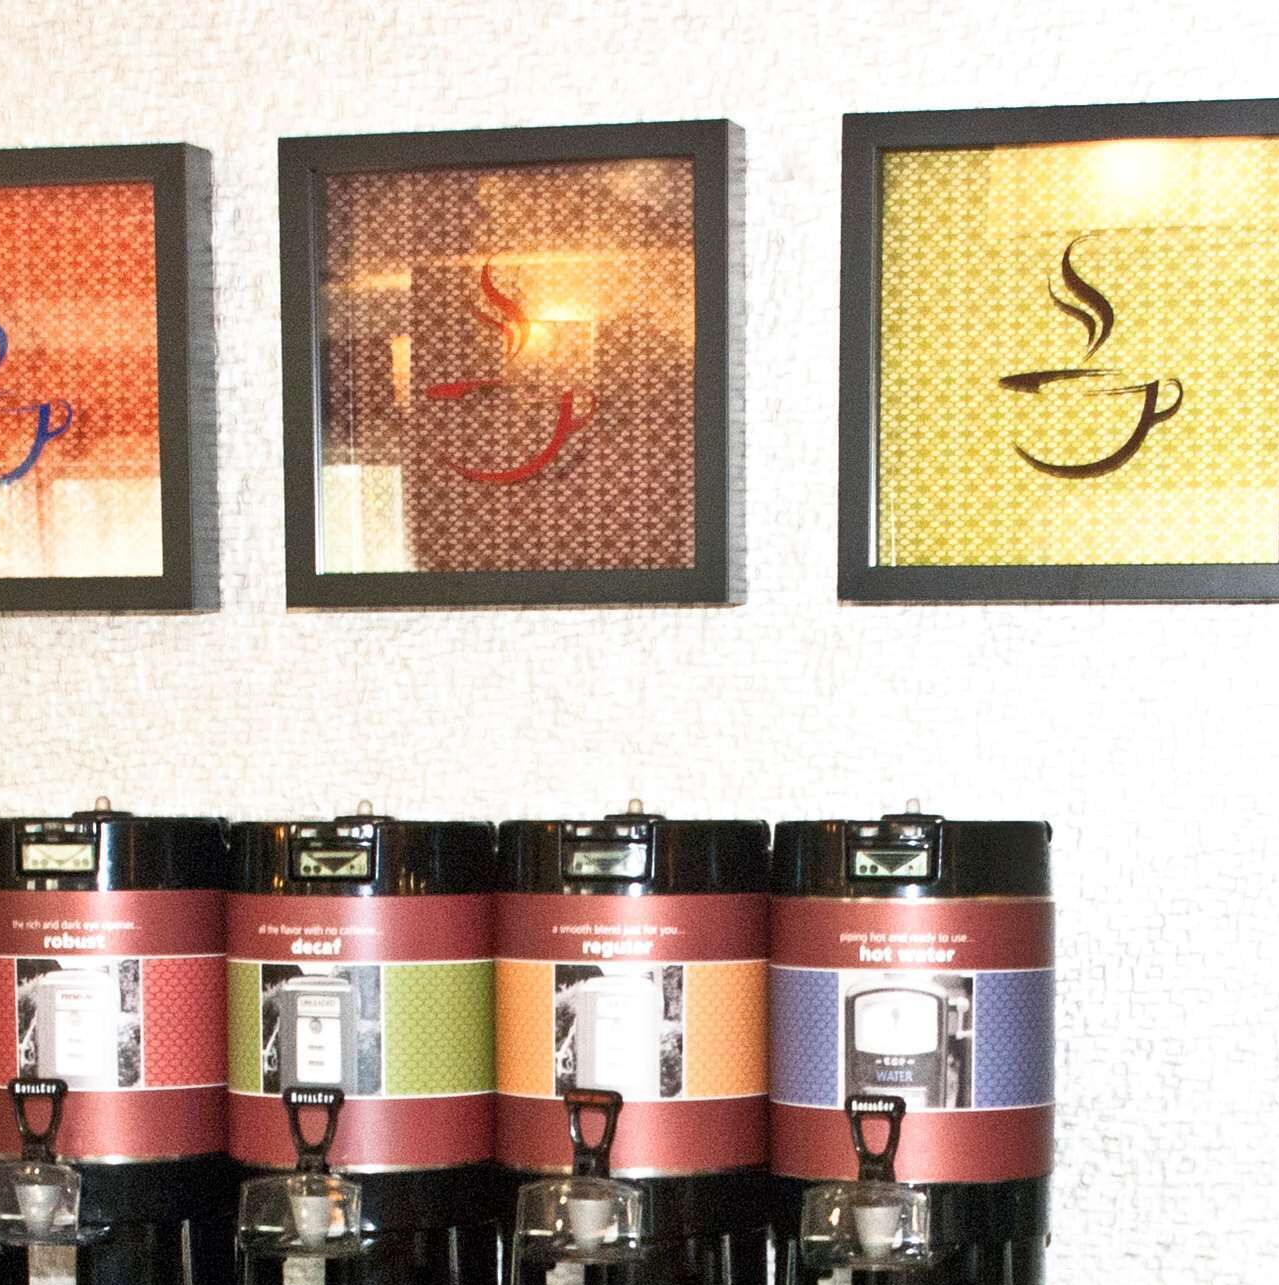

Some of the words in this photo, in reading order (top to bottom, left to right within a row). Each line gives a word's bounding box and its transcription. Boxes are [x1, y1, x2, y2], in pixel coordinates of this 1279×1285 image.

[43, 920, 59, 930] and
[61, 920, 81, 930] dark
[304, 925, 323, 935] with
[325, 927, 337, 935] no
[560, 925, 592, 934] smooth
[594, 924, 621, 934] blend
[43, 932, 106, 949] robust
[870, 932, 886, 942] hot
[938, 933, 949, 942] to
[291, 937, 342, 955] decaf
[582, 940, 654, 958] regular
[860, 944, 892, 962] hot
[898, 947, 955, 962] water
[876, 1071, 913, 1082] WATER
